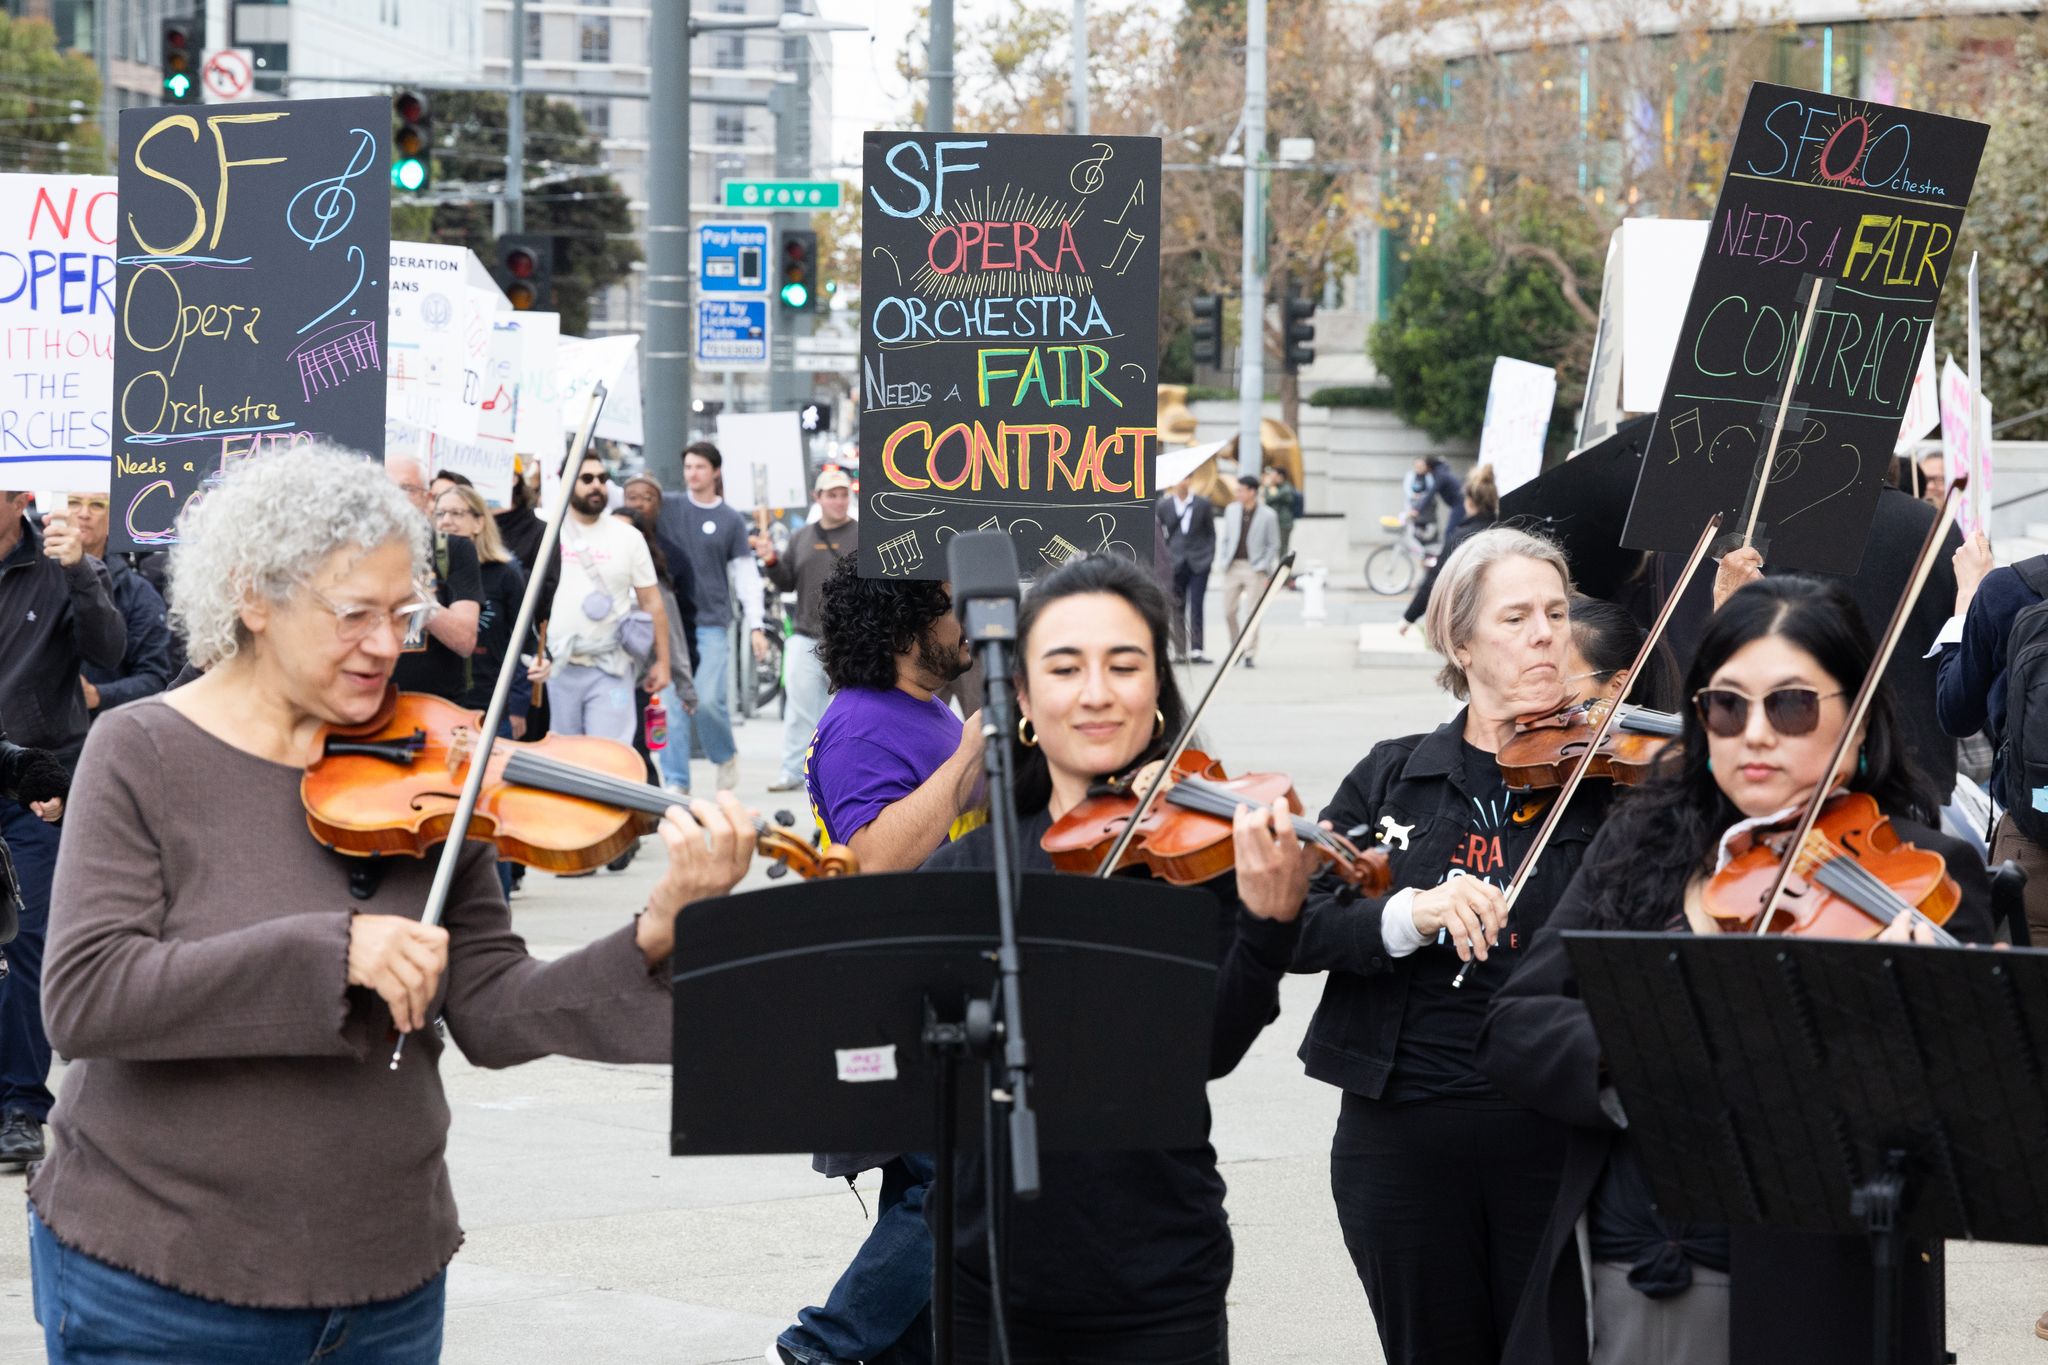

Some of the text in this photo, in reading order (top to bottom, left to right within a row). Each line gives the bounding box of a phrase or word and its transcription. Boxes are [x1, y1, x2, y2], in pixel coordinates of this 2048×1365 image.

[1747, 101, 1838, 178] SF
[128, 112, 291, 256] SF
[743, 185, 822, 205] Grove
[870, 140, 988, 219] SF
[390, 256, 459, 272] DERATION
[703, 229, 766, 248] Pay here
[927, 220, 1086, 274] OPERA
[1718, 203, 1952, 288] NEEDS A FAIR
[0, 250, 117, 315] OPER
[703, 300, 749, 318] Pay by
[7, 327, 114, 361] ITHOU
[124, 263, 262, 378] Opera
[872, 296, 1113, 344] ORCHESTRA
[943, 384, 962, 402] A
[977, 344, 1123, 408] FAIR
[1694, 295, 1934, 410] CONTRACT
[13, 372, 81, 400] THE
[121, 370, 282, 434] Orchestra
[0, 409, 111, 452] RCHES
[115, 452, 168, 478] Needs
[183, 461, 195, 472] a
[881, 420, 1157, 499] CONTRACT
[1450, 831, 1505, 873] ERA
